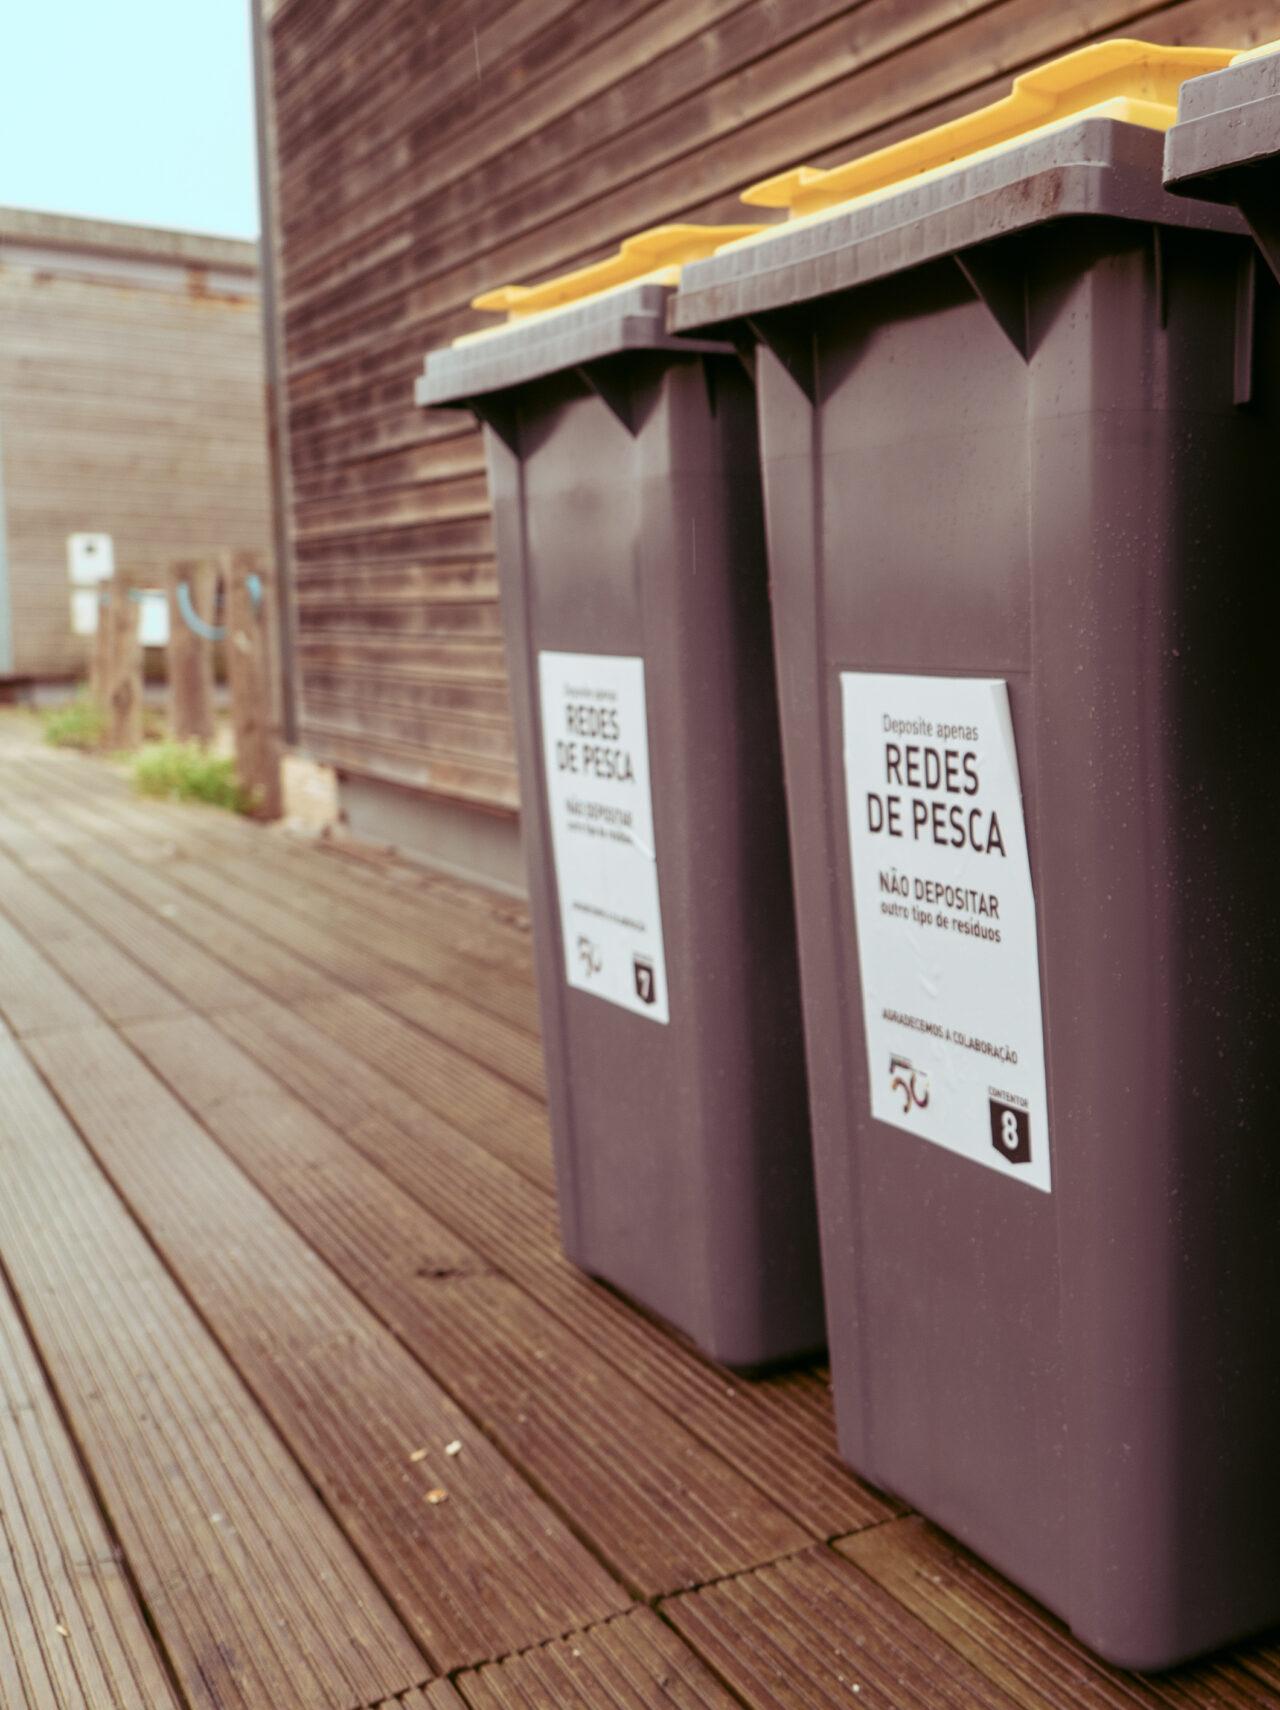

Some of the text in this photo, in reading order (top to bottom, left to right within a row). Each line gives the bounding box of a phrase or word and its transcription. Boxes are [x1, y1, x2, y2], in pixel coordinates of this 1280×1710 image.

[883, 713, 979, 742] Deposite apenas
[885, 743, 980, 796] REDES
[867, 792, 1007, 858] DE PESCA
[879, 866, 1000, 920] NÃO DEPOSITAR
[881, 901, 909, 919] outro
[912, 904, 933, 927] tipo
[936, 910, 949, 930] de
[882, 1008, 1019, 1064] AGRADECEMOS A COLABORAÇÃO
[988, 1085, 1030, 1108] CONTENTOR
[1001, 1110, 1019, 1150] 8
